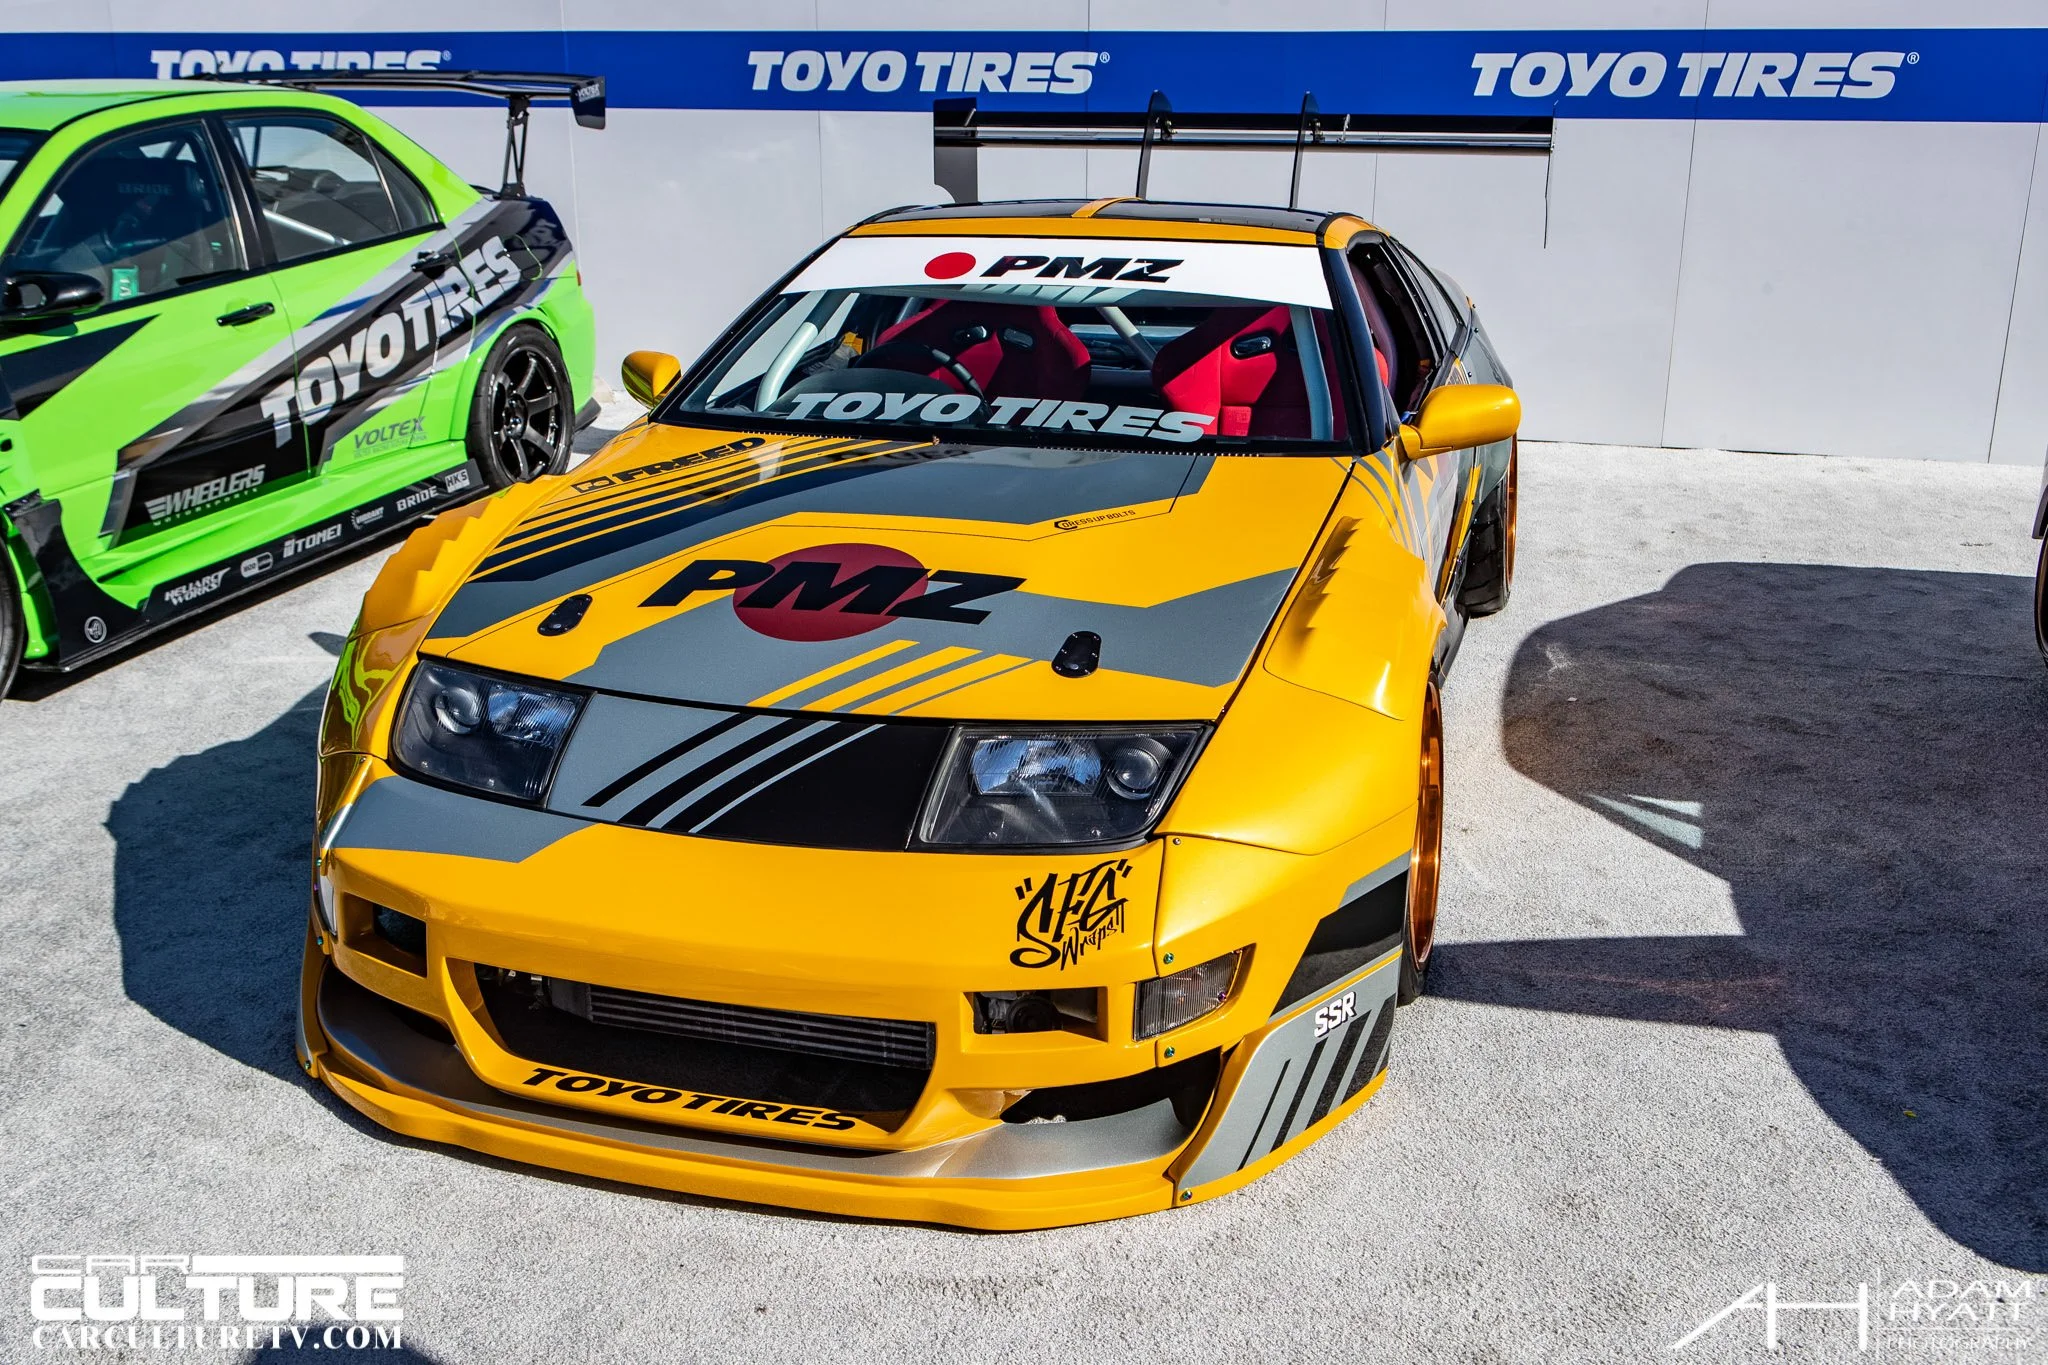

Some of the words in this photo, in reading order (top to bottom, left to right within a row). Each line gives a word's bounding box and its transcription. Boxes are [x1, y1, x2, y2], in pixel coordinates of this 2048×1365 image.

[748, 50, 907, 92] TOYO
[1471, 51, 1667, 97] TOYO
[979, 255, 1185, 283] PMZ
[354, 415, 426, 449] VOLTEX
[785, 392, 981, 422] TOYO
[988, 395, 1216, 443] TIRES
[446, 470, 468, 488] HKS
[612, 437, 766, 482] FREED
[162, 464, 266, 515] WHEELERS
[396, 485, 439, 512] BRIDE
[1106, 510, 1136, 520] BOLTS
[296, 523, 342, 553] TOMEI
[638, 559, 1028, 625] PMZ
[1314, 991, 1357, 1038] SSR
[522, 1067, 683, 1104] TOYO
[682, 1093, 865, 1131] TIRES
